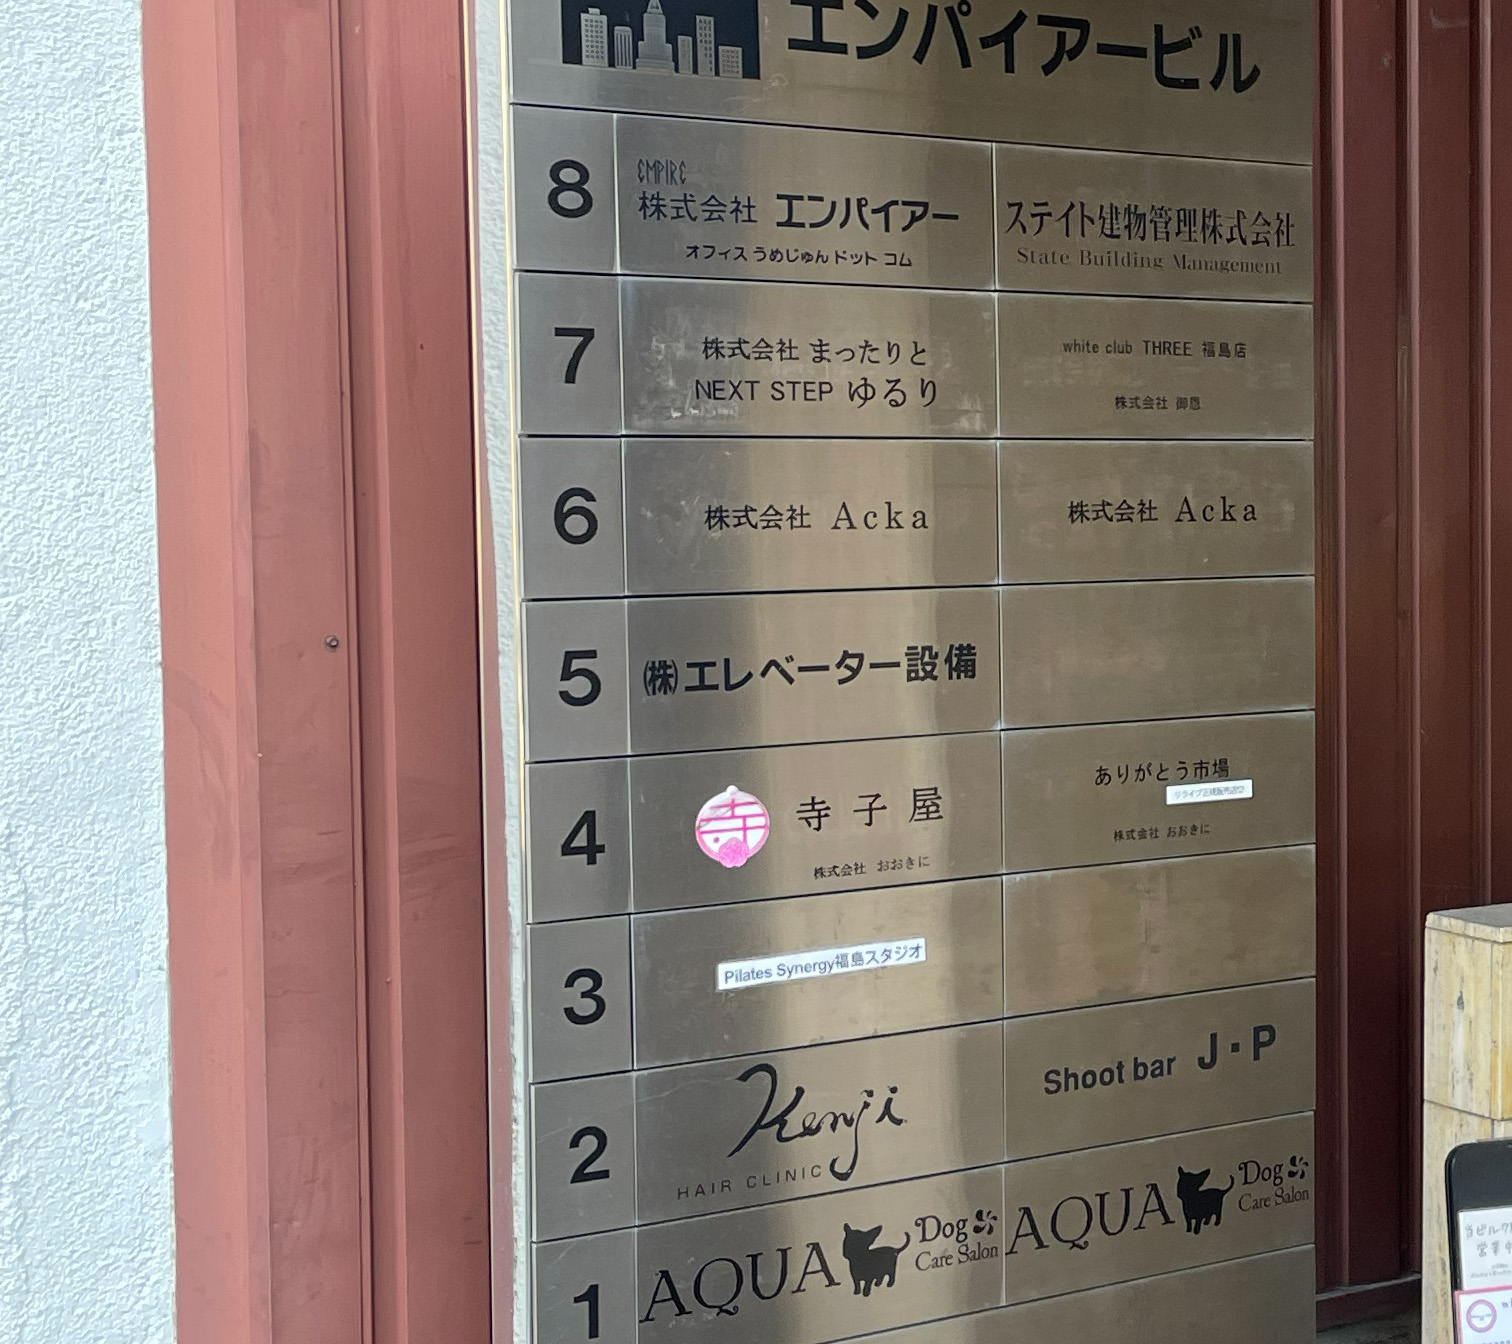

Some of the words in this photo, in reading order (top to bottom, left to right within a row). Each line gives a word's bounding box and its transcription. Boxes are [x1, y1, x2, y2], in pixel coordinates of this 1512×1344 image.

[547, 159, 593, 219] 8
[638, 191, 758, 224] 株式会社
[775, 193, 960, 233] エンパイアー
[1004, 200, 1297, 249] ステイト建物管理株式会社
[1017, 247, 1070, 266] State
[1080, 249, 1164, 271] Building
[1172, 253, 1283, 275] Management
[553, 327, 596, 385] 7
[701, 337, 800, 362] 株式会社
[812, 339, 928, 366] まったりと
[1062, 338, 1099, 354] white
[1105, 339, 1133, 355] club
[1143, 340, 1193, 357] THREE
[1201, 341, 1247, 358] 福島店
[695, 379, 760, 402] NEXT
[771, 380, 834, 402] STEP
[848, 377, 938, 410] ゆるり
[1115, 396, 1169, 410] 株式会社
[553, 487, 599, 545] 6
[704, 504, 812, 531] 株式会社
[830, 501, 930, 531] Acka
[1067, 499, 1159, 524] 株式会社
[1174, 496, 1258, 523] Acka
[558, 649, 602, 707] 5
[1094, 757, 1231, 787] ありがとう市場
[561, 809, 606, 866] 4
[1113, 827, 1160, 842] 株式会社
[1167, 824, 1211, 839] おおきに
[813, 862, 866, 880] 株式会社
[876, 856, 930, 873] おおきに
[723, 964, 774, 985] Pilates
[563, 968, 606, 1026] 3
[1043, 1061, 1125, 1096] Shoot
[1133, 1055, 1177, 1082] bar
[727, 1063, 908, 1181] Kenji
[569, 1126, 610, 1184] 2
[677, 1179, 733, 1200] HAIR
[746, 1164, 823, 1189] CLINIC
[1237, 1159, 1285, 1187] Dog
[1238, 1189, 1271, 1213] Care
[1274, 1186, 1310, 1207] Salon
[914, 1216, 969, 1244] Dog
[1004, 1183, 1176, 1256] AQUA
[915, 1247, 954, 1272] Care
[957, 1242, 999, 1266] Salon
[638, 1241, 842, 1324] AQUA
[572, 1283, 601, 1340] 1
